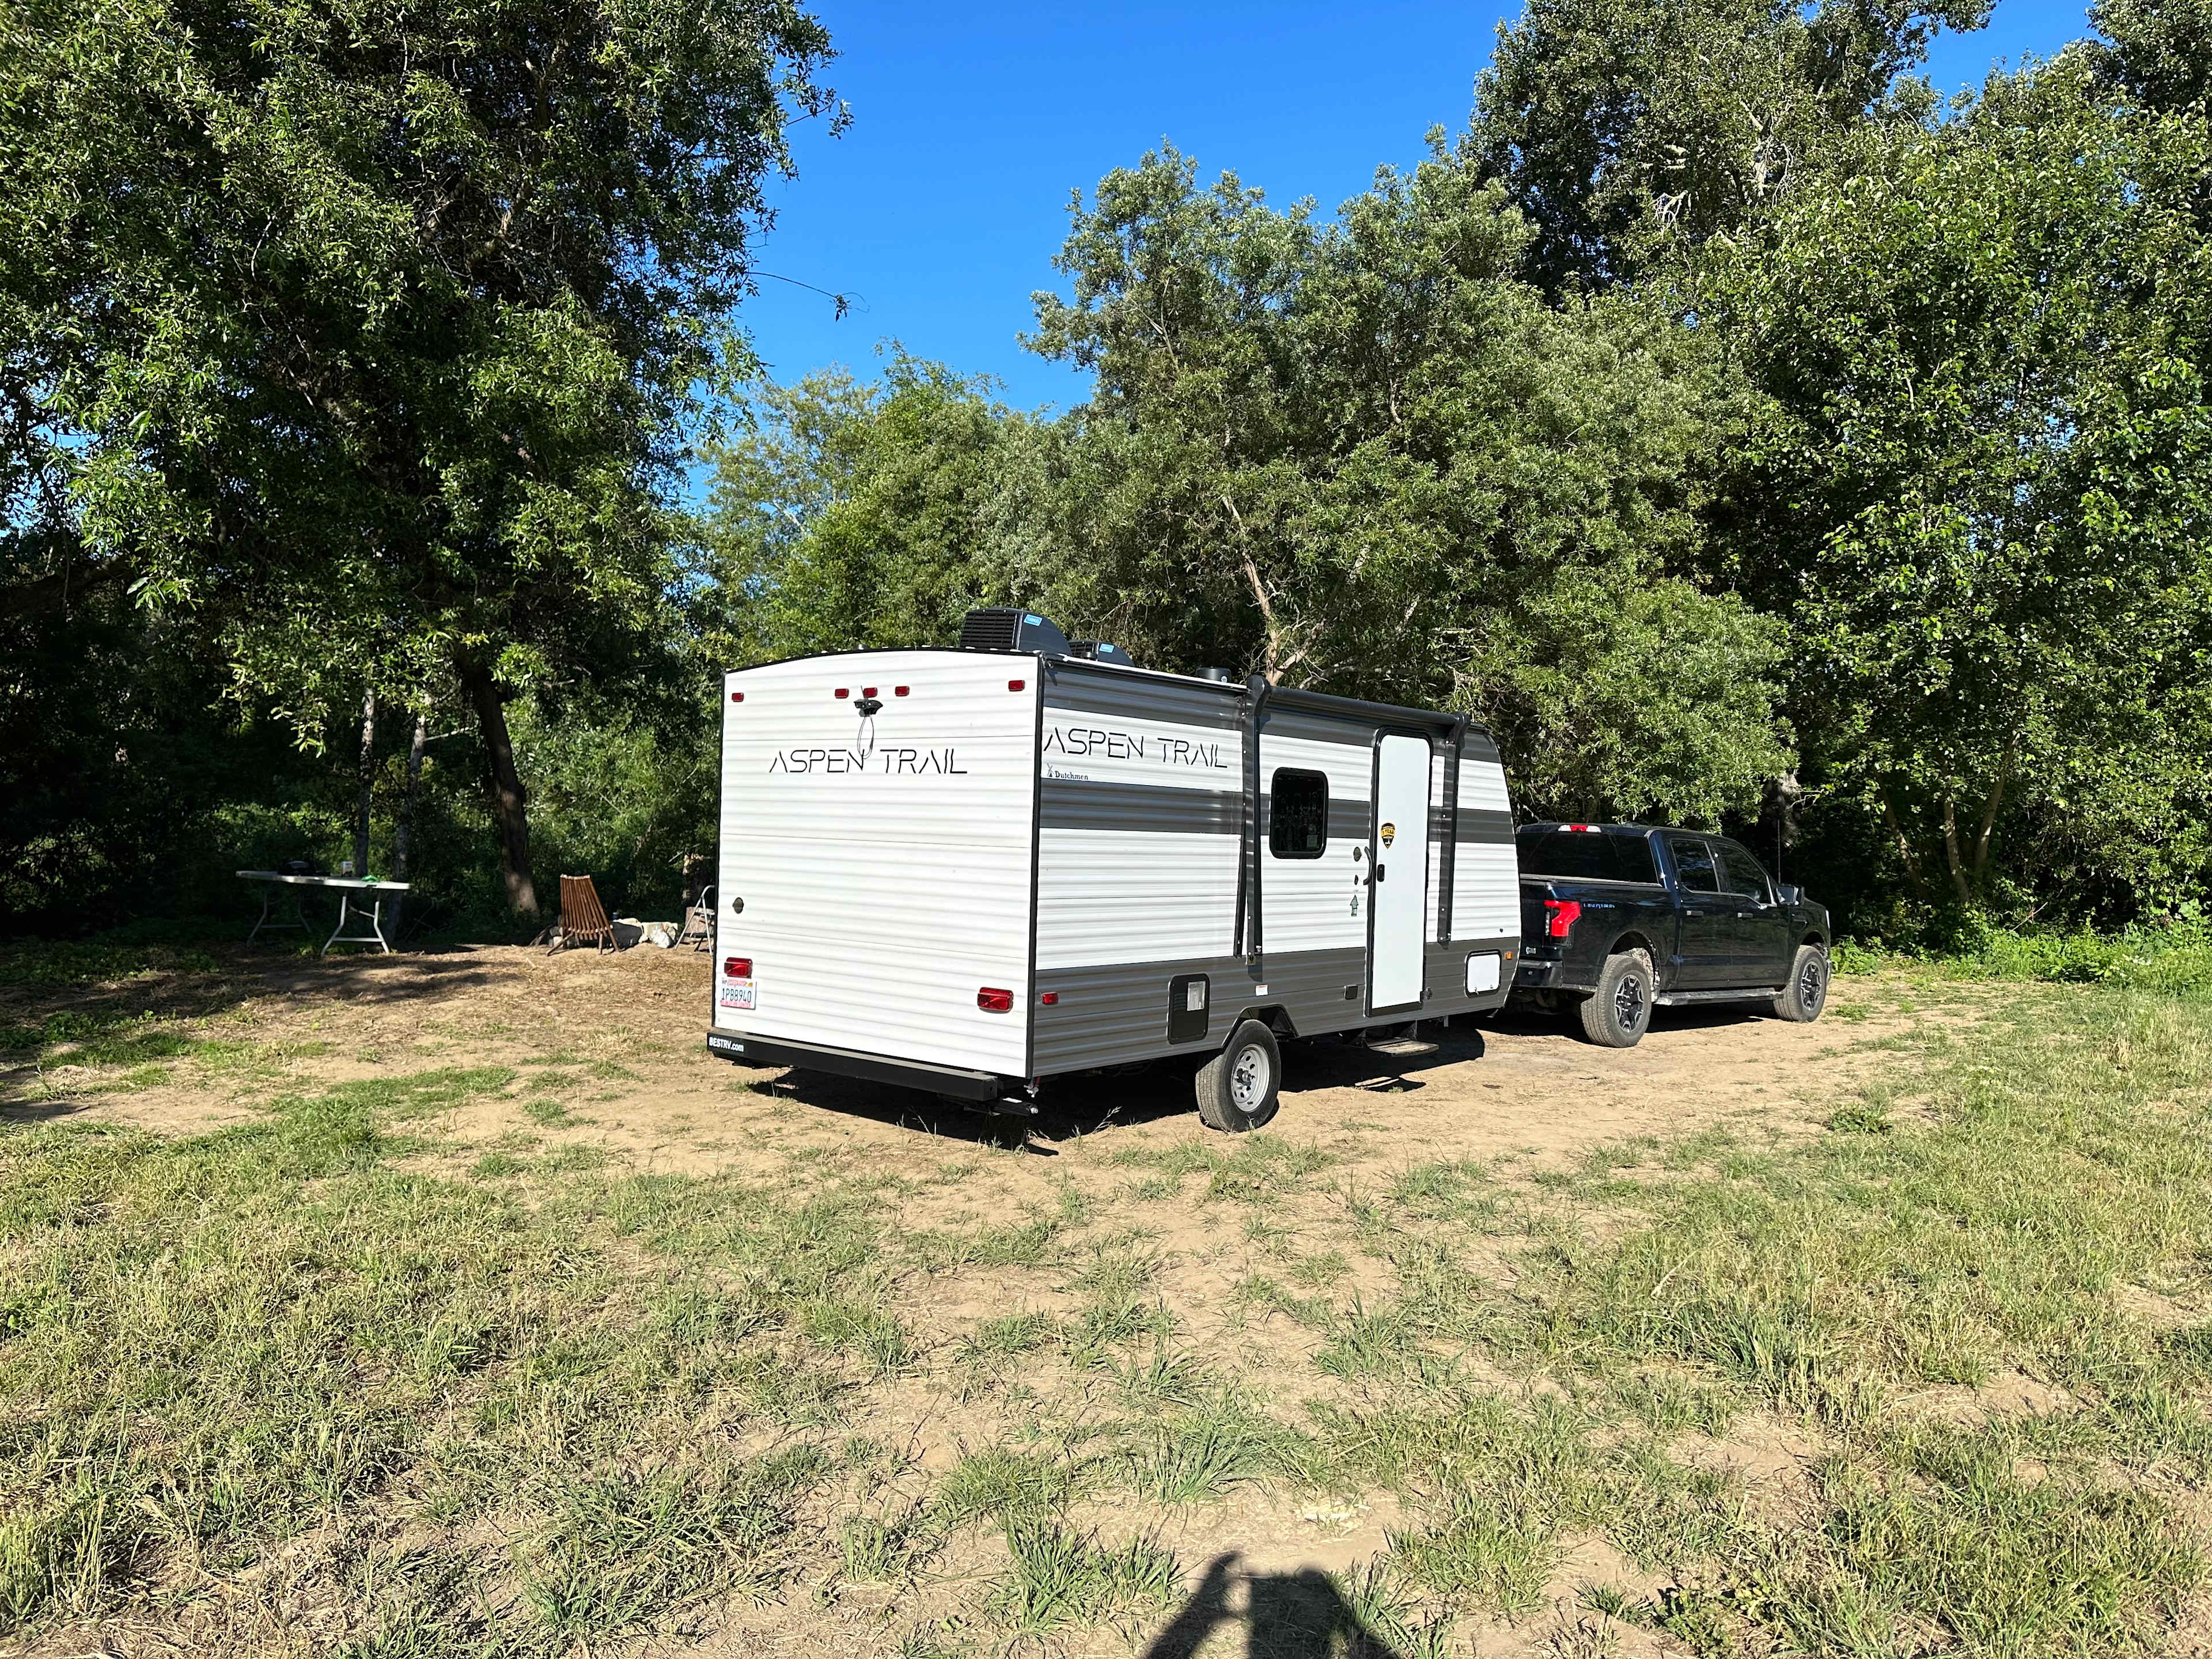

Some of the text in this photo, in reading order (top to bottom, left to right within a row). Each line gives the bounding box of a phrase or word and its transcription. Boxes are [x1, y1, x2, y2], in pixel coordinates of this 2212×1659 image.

[1044, 726, 1228, 768] ASPEN TRAIL
[769, 748, 968, 774] ASPEN TRAIL
[1055, 771, 1088, 780] Dutchmen
[709, 1036, 744, 1052] BESTRV.com
